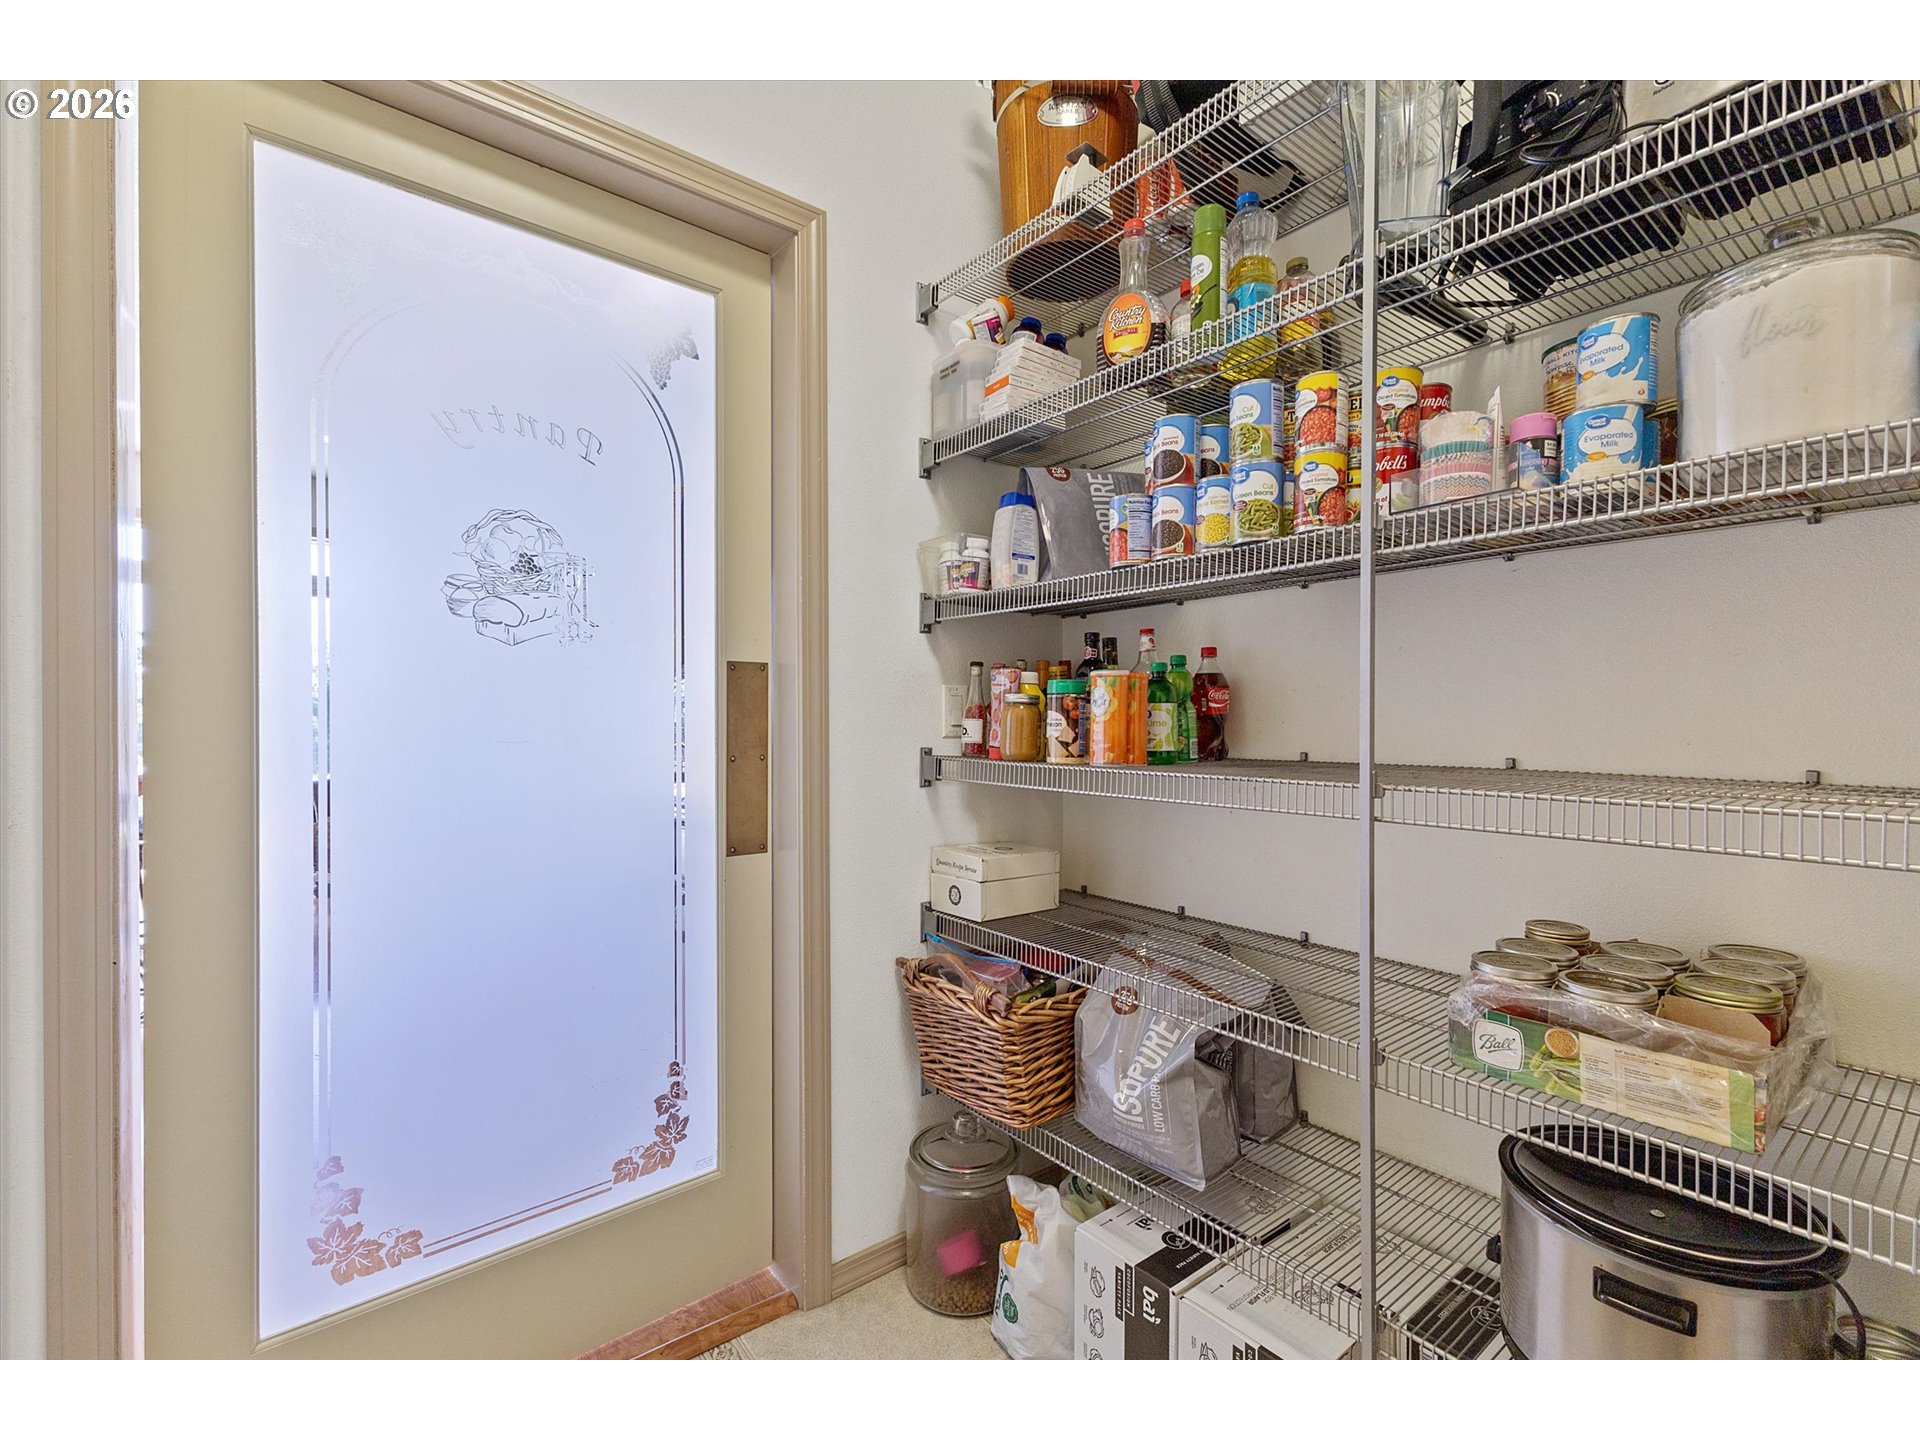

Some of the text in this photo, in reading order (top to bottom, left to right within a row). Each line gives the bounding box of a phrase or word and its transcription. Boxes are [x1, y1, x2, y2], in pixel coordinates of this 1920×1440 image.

[1108, 305, 1145, 322] Country
[1109, 316, 1143, 333] Kitchen
[1579, 344, 1624, 364] Evaporated
[1590, 357, 1606, 368] Milk
[1242, 405, 1254, 413] Cut
[1584, 431, 1633, 443] Evaporated
[1600, 440, 1619, 448] Milk
[1376, 455, 1408, 471] bell's
[1253, 489, 1274, 497] Beans
[1262, 482, 1274, 490] Cut
[1480, 1033, 1516, 1051] Ball
[1112, 1016, 1181, 1123] ISOPURE
[1150, 1084, 1165, 1133] LOW CARB
[1142, 1285, 1162, 1326] bai
